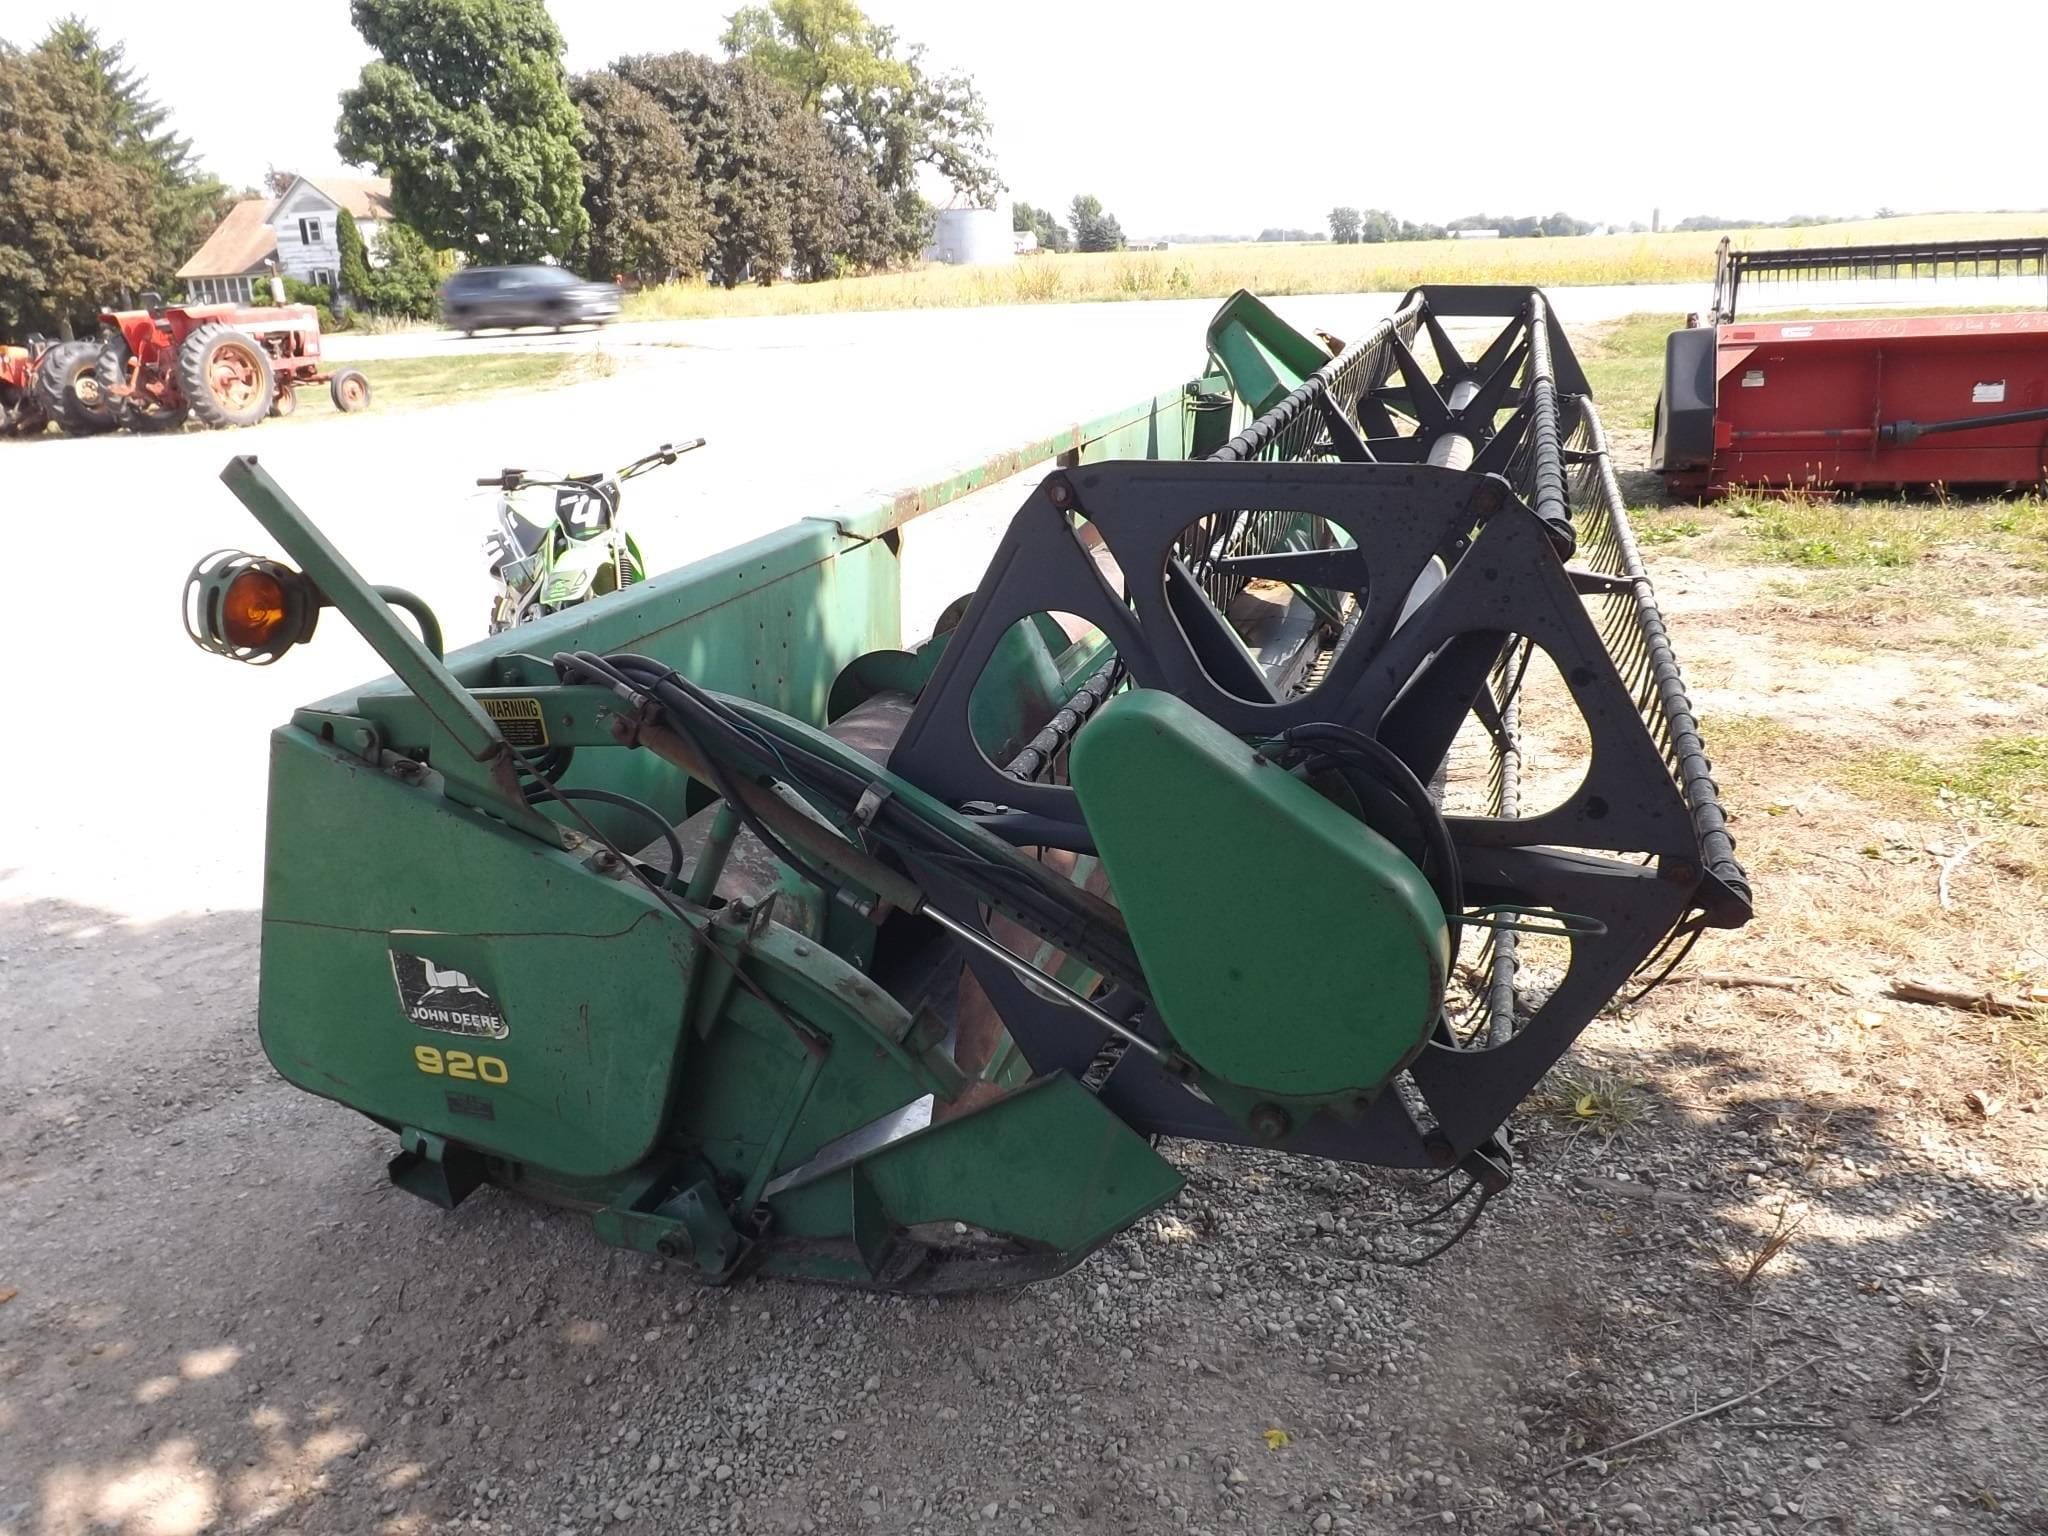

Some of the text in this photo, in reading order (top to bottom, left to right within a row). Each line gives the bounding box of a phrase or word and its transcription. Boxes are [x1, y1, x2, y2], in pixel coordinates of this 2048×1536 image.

[485, 701, 538, 717] WARNING
[411, 1007, 500, 1029] JOHN DEERE
[415, 1045, 509, 1084] 920
